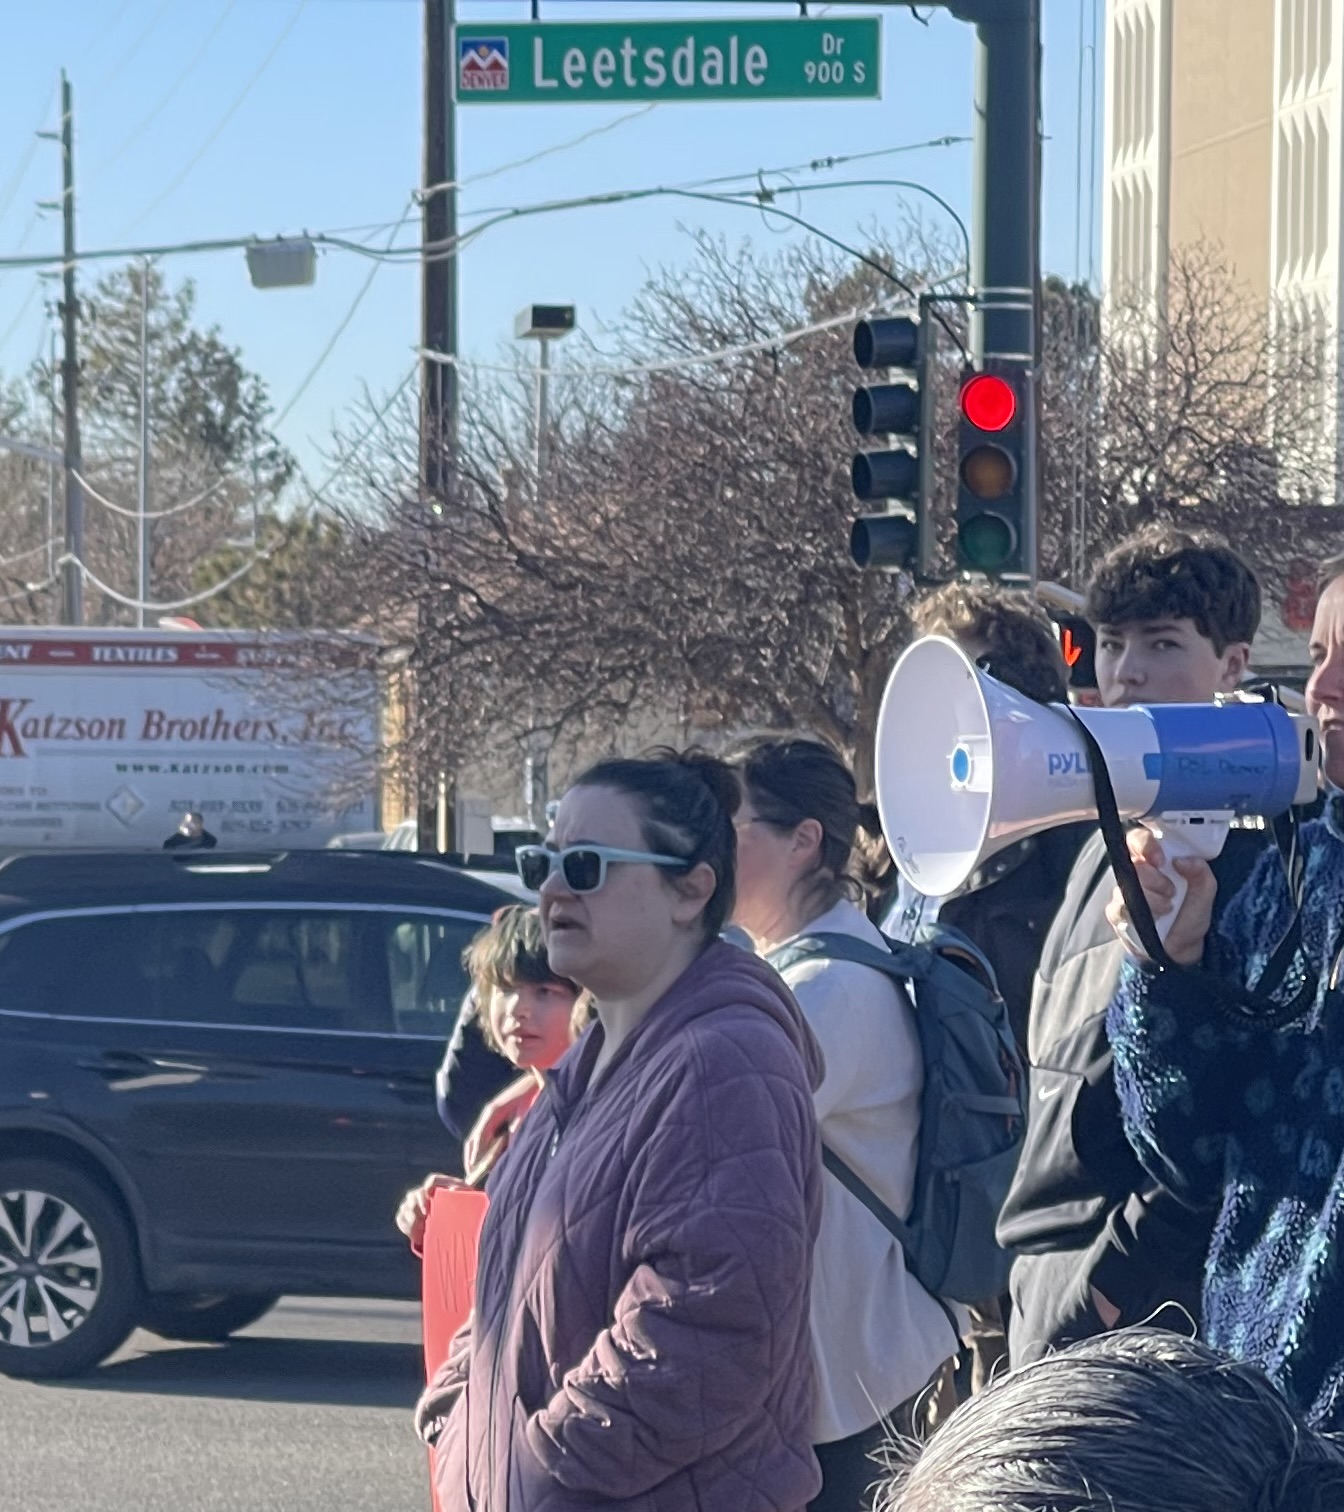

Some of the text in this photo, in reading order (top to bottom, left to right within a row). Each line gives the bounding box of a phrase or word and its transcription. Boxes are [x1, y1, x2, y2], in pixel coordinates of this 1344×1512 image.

[821, 33, 845, 56] Dr
[533, 35, 769, 88] Leetsdale
[804, 60, 866, 84] 900 S
[92, 646, 179, 663] TEXTILES
